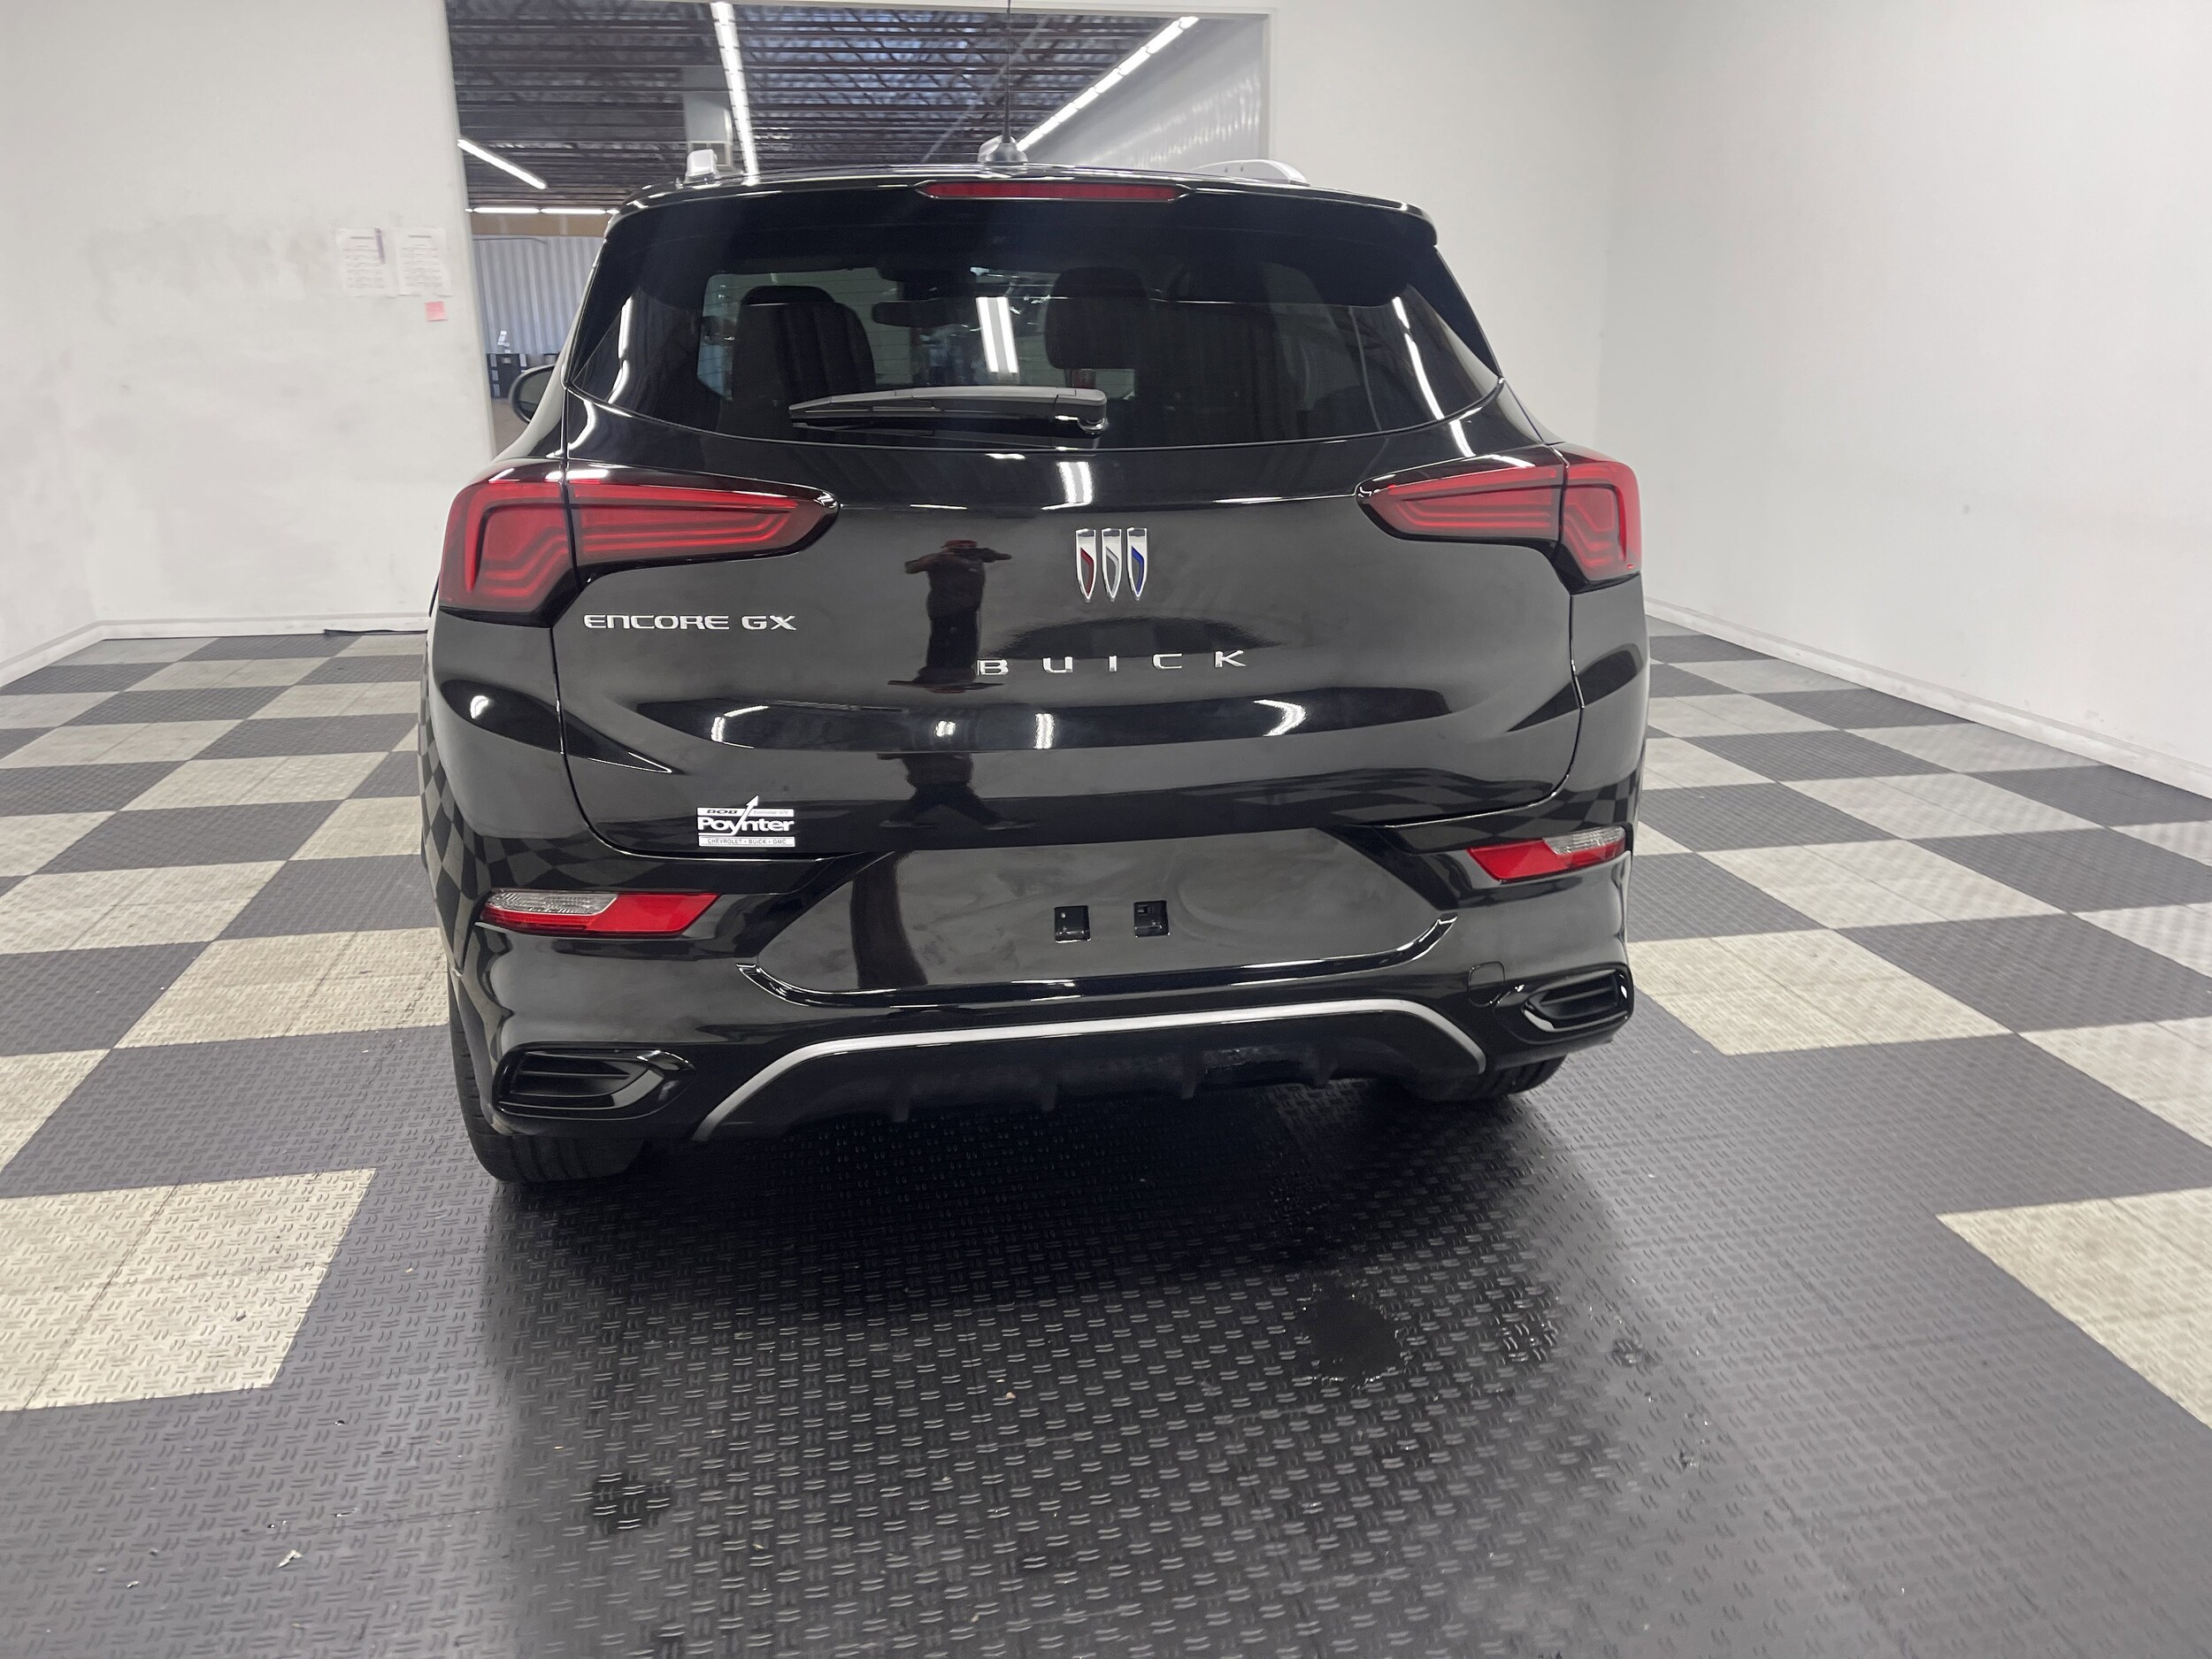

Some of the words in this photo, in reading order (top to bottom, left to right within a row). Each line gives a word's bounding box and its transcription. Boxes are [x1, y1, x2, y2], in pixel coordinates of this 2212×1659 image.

[584, 614, 730, 630] ENCORE
[741, 615, 797, 631] GX
[977, 650, 1247, 676] BUICK
[697, 816, 794, 833] Poynter
